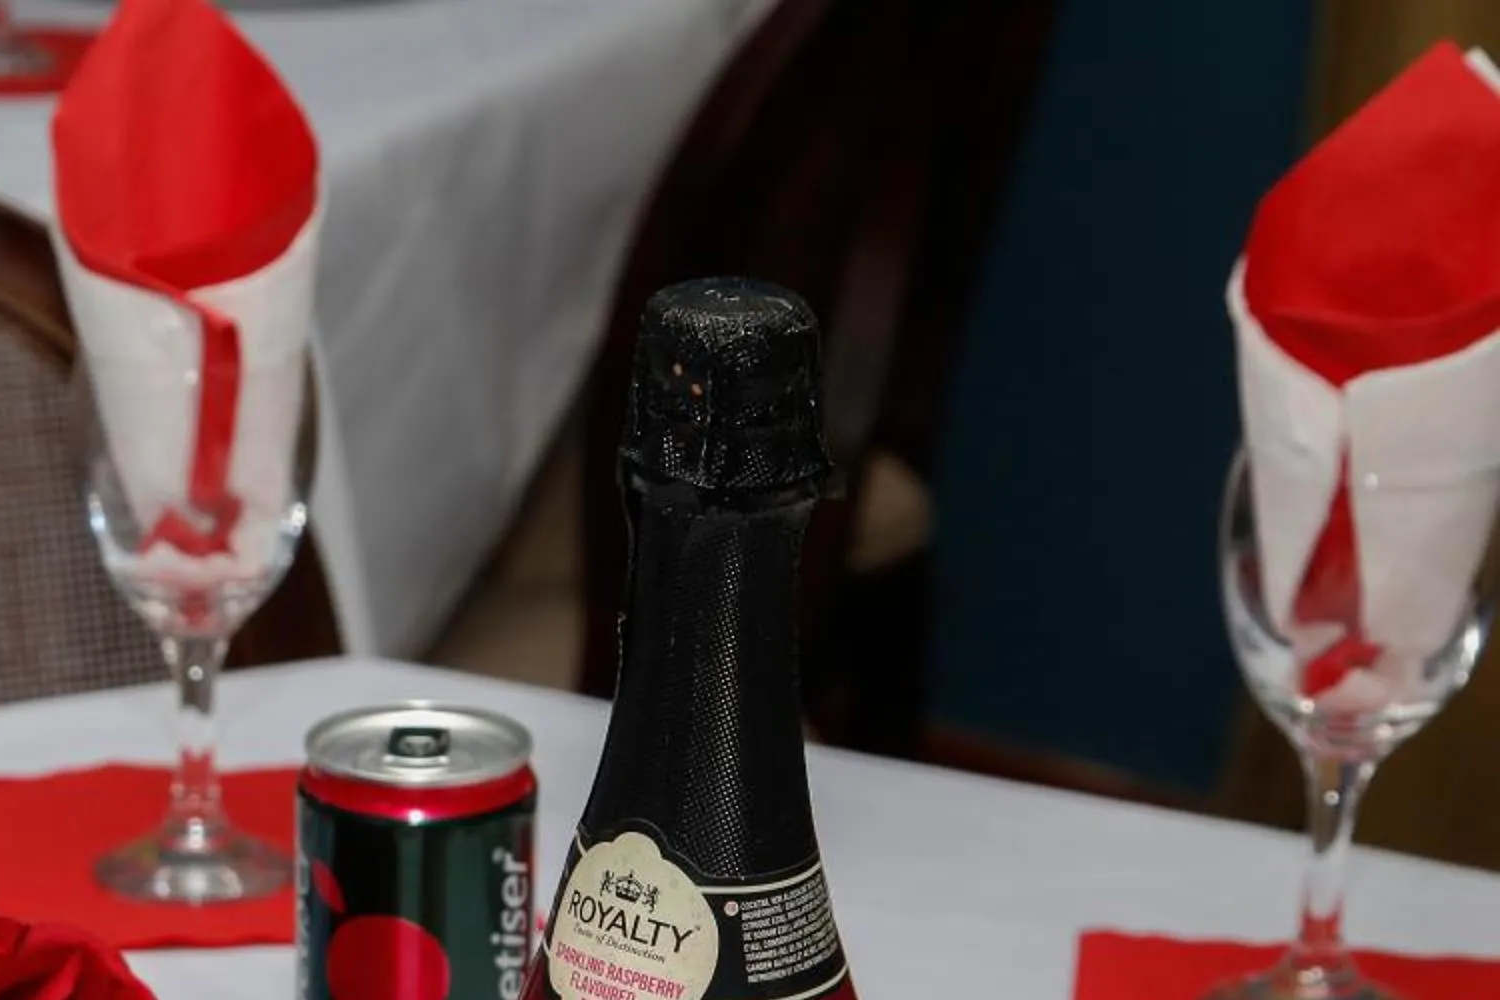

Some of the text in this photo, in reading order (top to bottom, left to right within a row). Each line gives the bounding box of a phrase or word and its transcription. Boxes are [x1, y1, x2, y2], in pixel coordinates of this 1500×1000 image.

[568, 889, 694, 953] ROYALTY
[555, 941, 685, 1000] SPARKLING RASPBERRY
